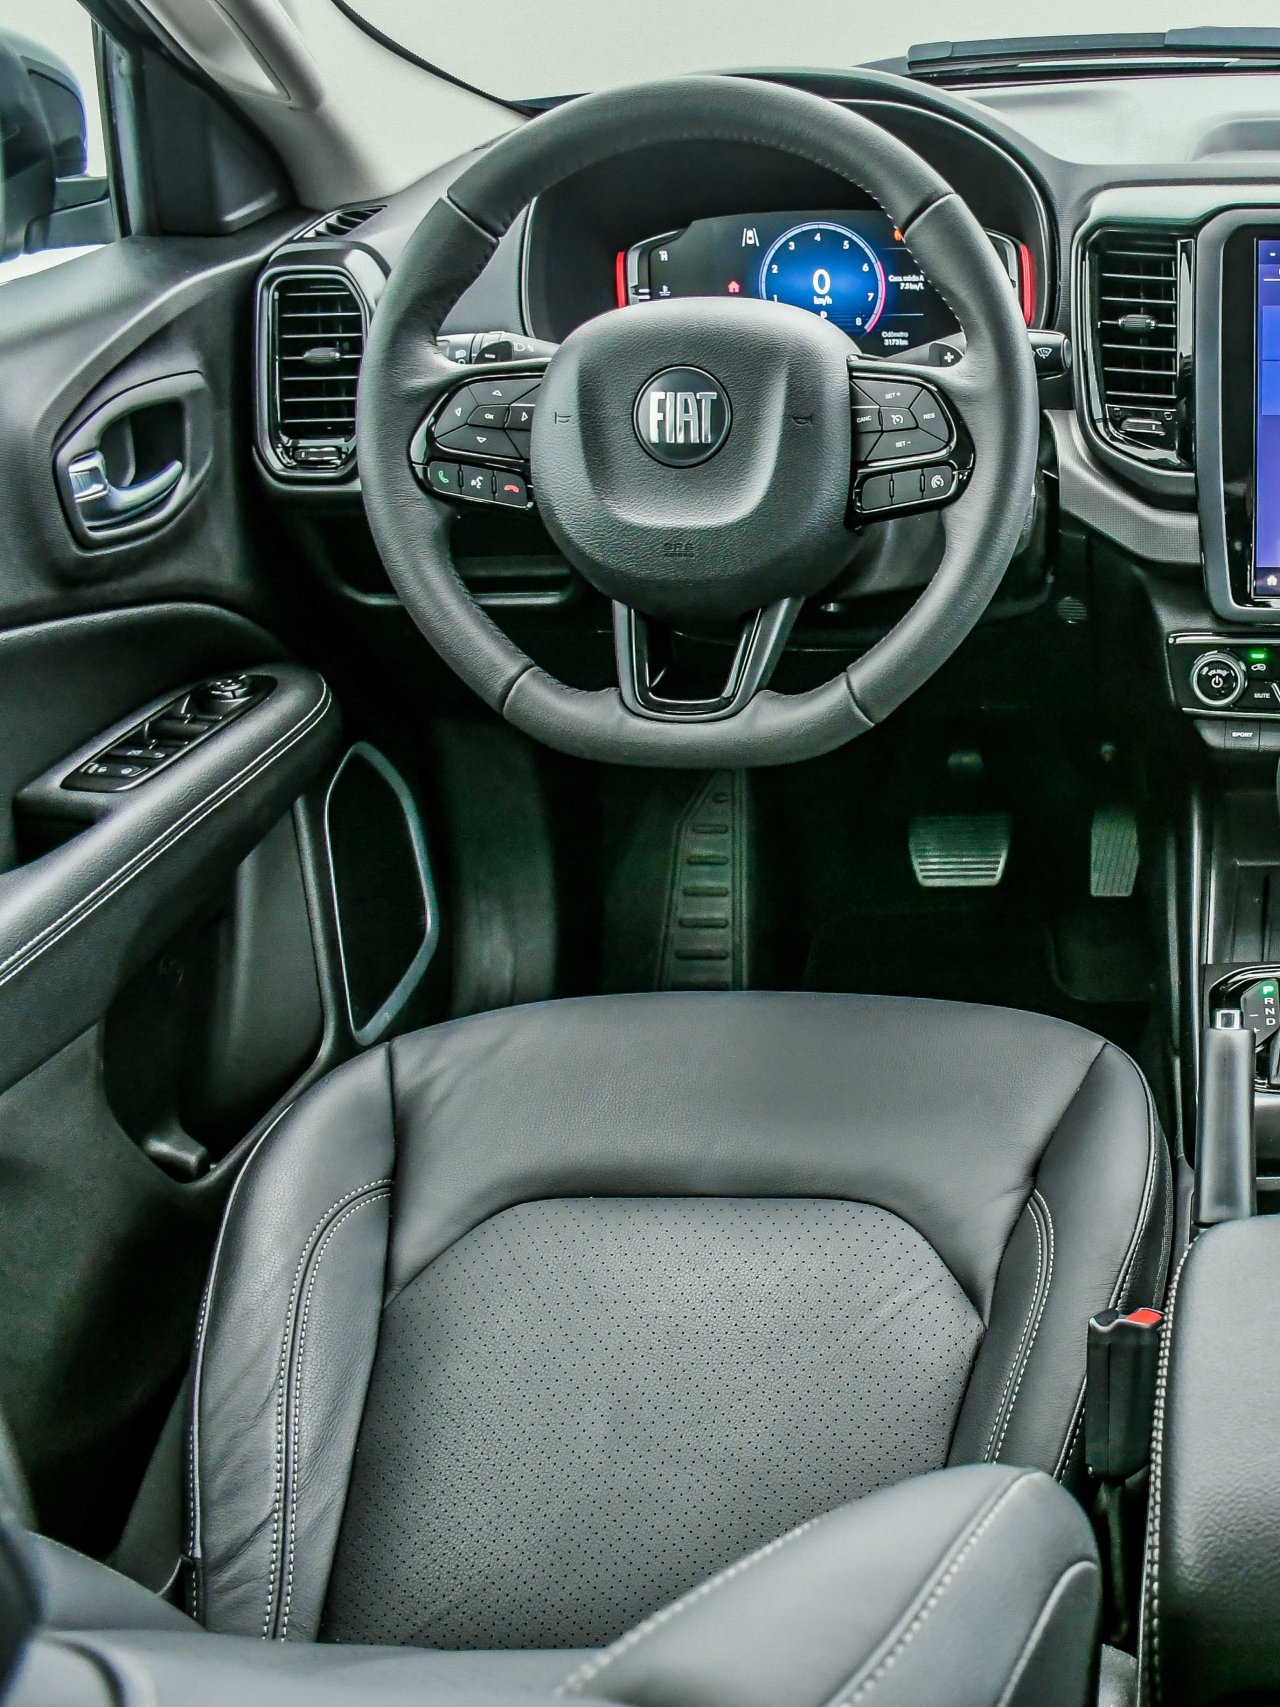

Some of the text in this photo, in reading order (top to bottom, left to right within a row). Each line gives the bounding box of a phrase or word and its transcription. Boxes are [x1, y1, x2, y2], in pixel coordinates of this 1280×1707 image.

[814, 233, 821, 241] 4
[788, 241, 795, 250] 3
[842, 240, 849, 249] 5
[771, 264, 778, 273] 2
[862, 263, 869, 272] 6
[812, 268, 831, 294] 0
[813, 295, 832, 305] km/h
[867, 292, 874, 301] 7
[855, 317, 862, 326] 8
[649, 391, 718, 444] FIAT
[1262, 985, 1274, 995] P
[1264, 997, 1274, 1005] R
[1265, 1007, 1276, 1015] N
[1266, 1017, 1276, 1026] D
